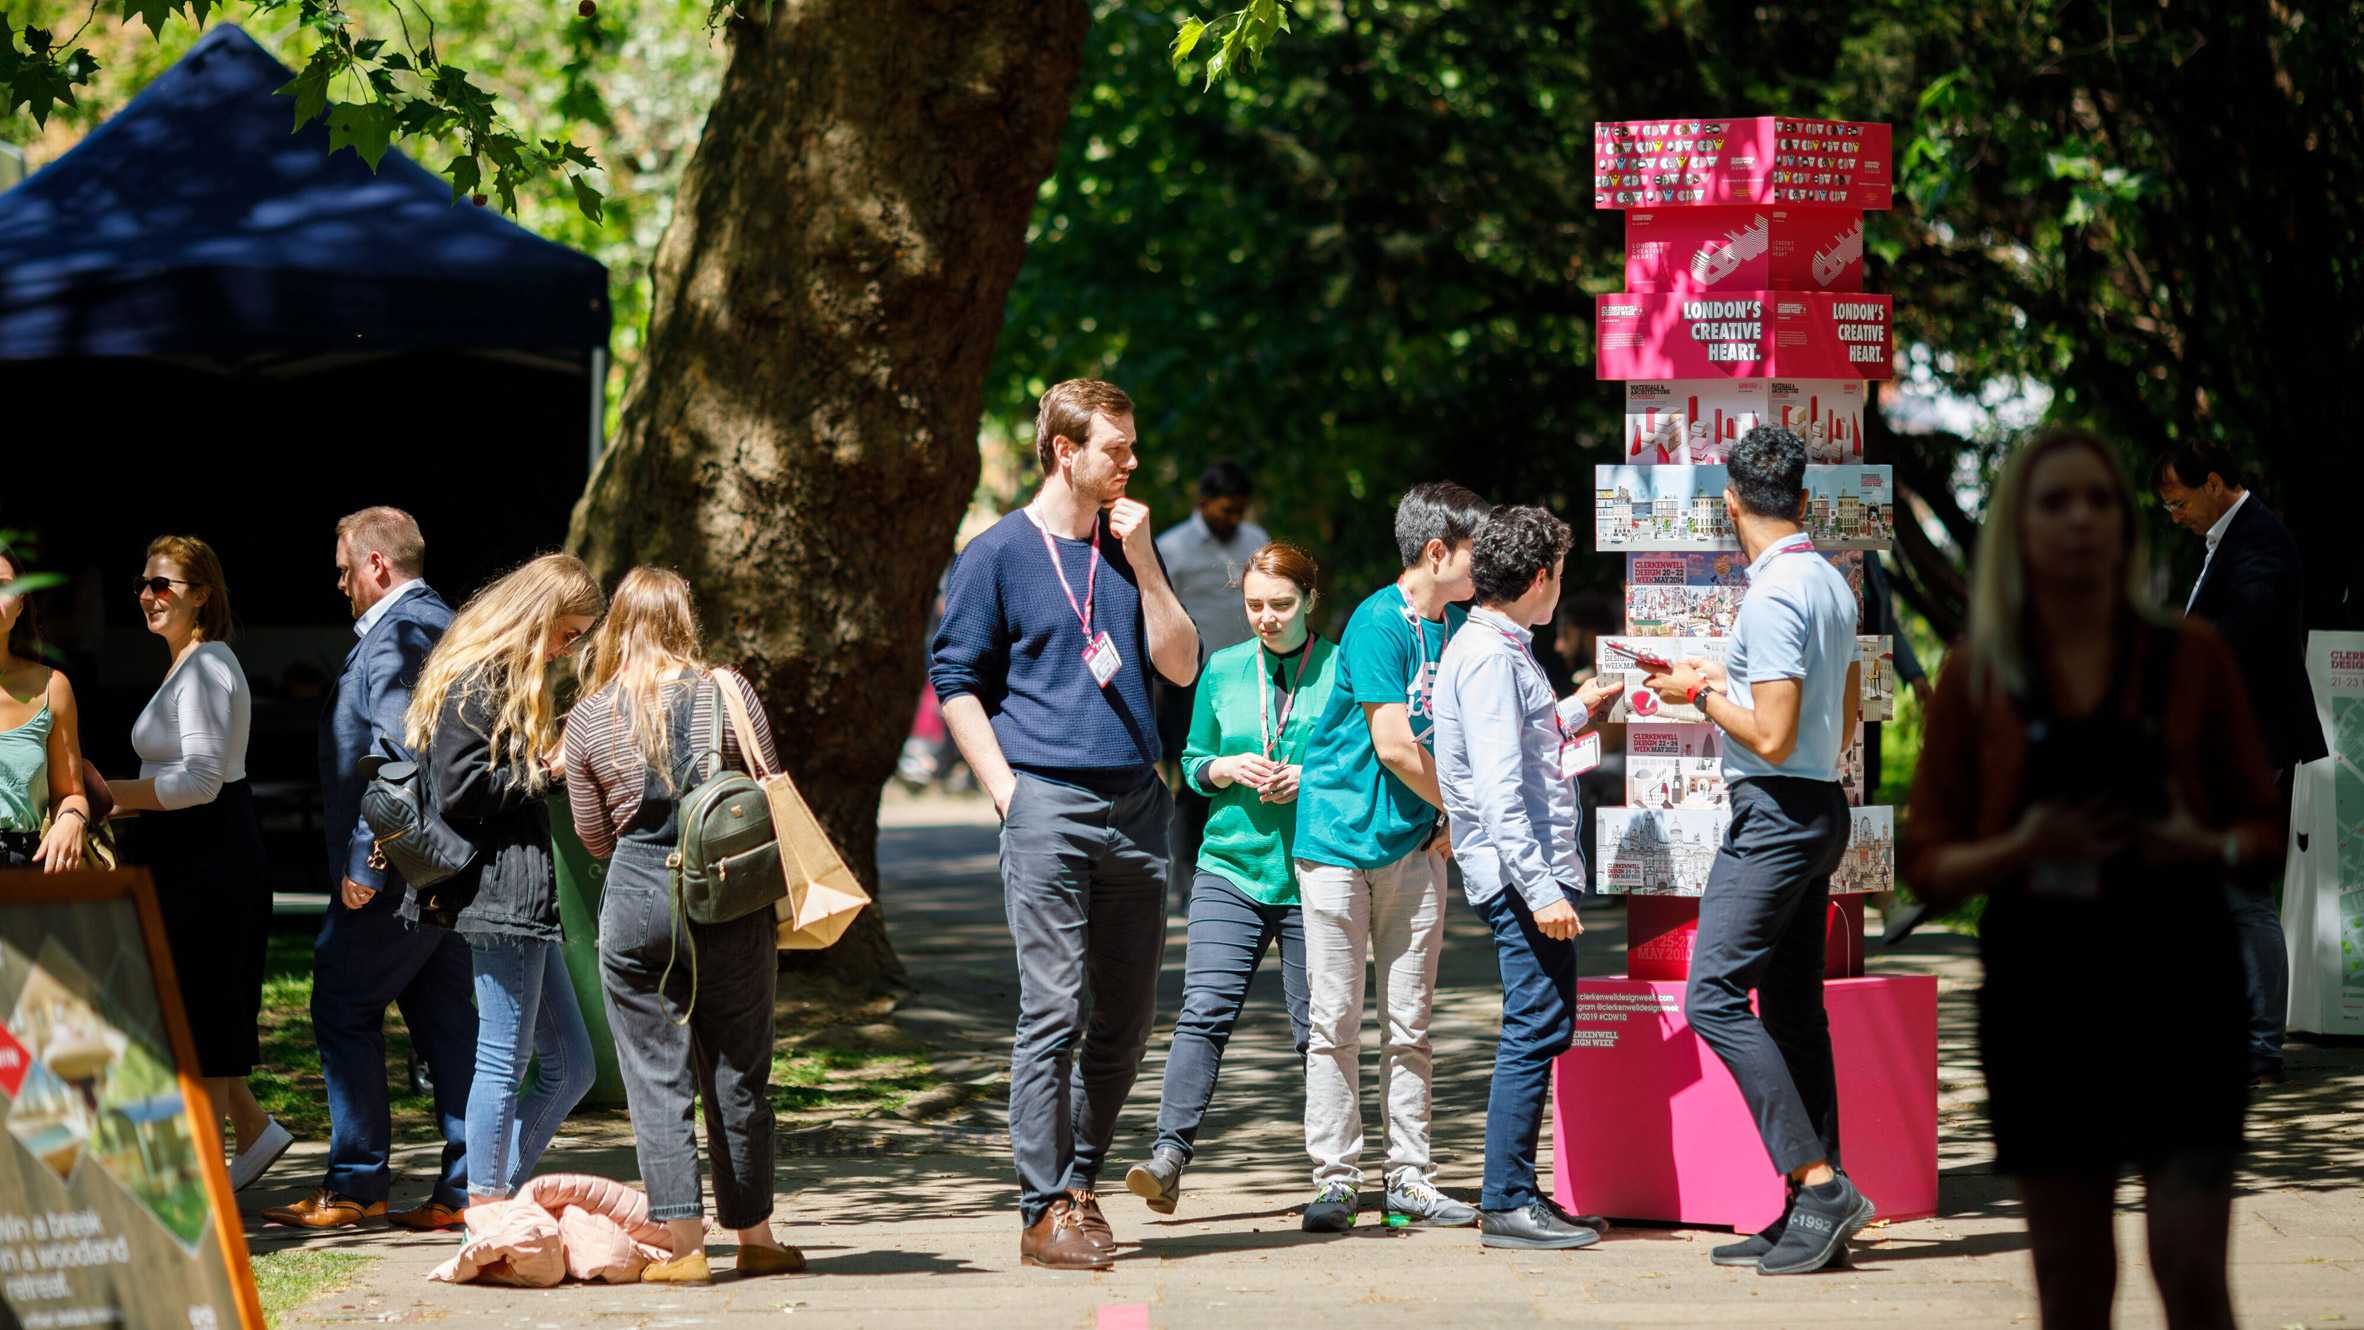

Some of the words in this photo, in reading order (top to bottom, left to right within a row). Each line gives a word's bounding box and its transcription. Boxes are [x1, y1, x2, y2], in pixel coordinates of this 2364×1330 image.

[1683, 302, 1761, 319] LONDON'S
[1833, 303, 1884, 320] LONDON'S
[1691, 322, 1761, 340] CREATIVE
[1838, 325, 1884, 342] CREATIVE
[1708, 344, 1761, 361] HEART.
[1849, 345, 1884, 363] HEART.
